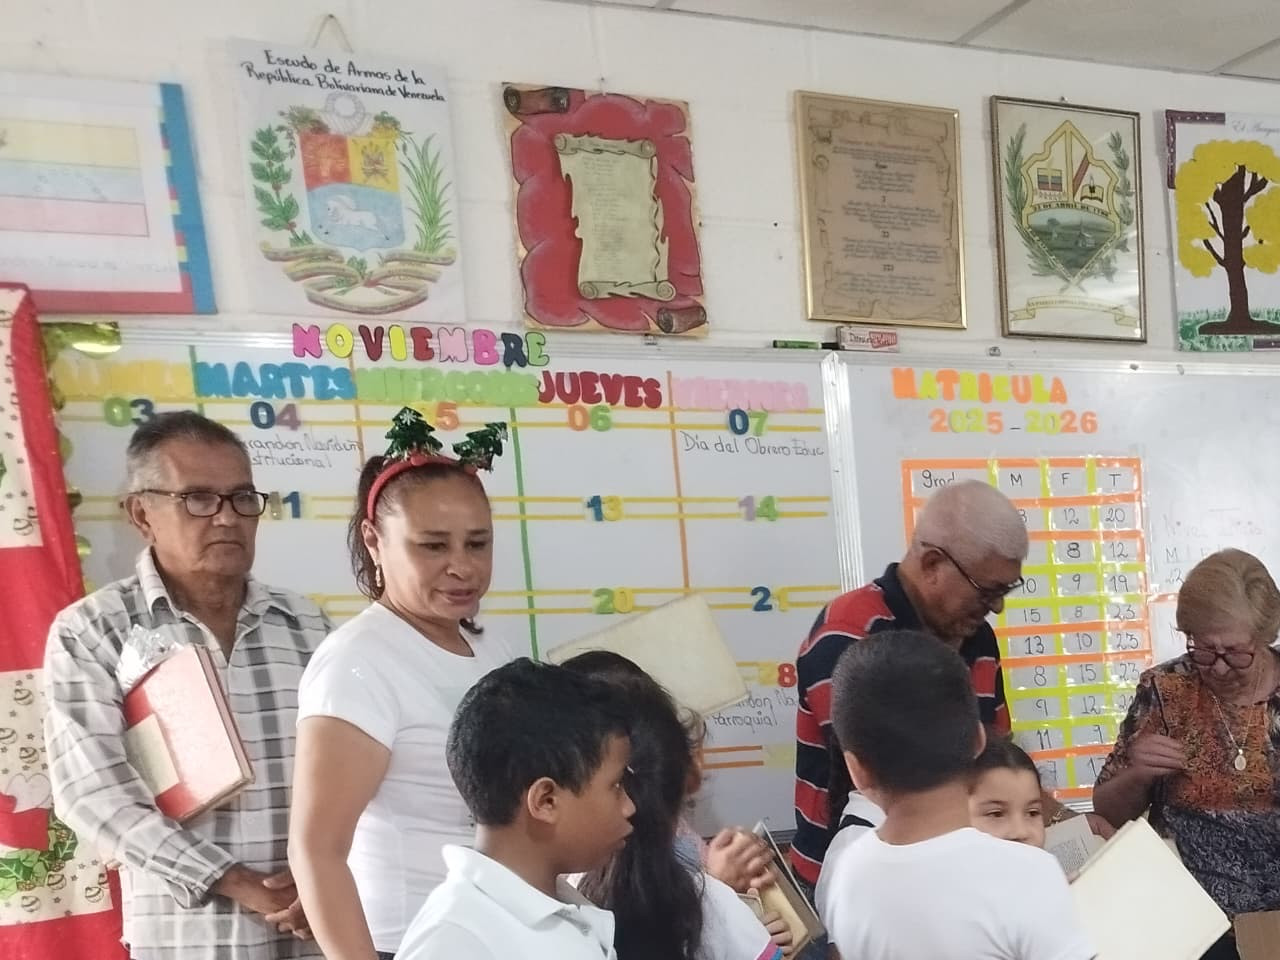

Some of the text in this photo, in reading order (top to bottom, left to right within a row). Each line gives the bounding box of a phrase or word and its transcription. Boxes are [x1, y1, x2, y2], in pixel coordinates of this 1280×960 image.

[264, 50, 426, 85] Escudo de Armas de la
[385, 85, 397, 96] de
[398, 87, 446, 102] Venezuela
[292, 323, 550, 366] NOVIEMBRE
[194, 361, 358, 401] MARTES
[537, 370, 662, 410] JUEVES
[891, 368, 1067, 405] MATRICULA
[104, 397, 154, 427] 03
[250, 400, 301, 431] 04
[415, 401, 460, 431] 5
[567, 405, 613, 431] 06
[728, 408, 769, 437] 07
[714, 436, 738, 453] del
[745, 437, 790, 456] Obrero
[1010, 473, 1023, 486] M
[1062, 473, 1070, 485] F
[1109, 473, 1122, 487] T
[586, 495, 624, 521] 13
[738, 496, 779, 521] 14
[1063, 508, 1079, 524] 12
[1105, 507, 1126, 523] 20
[1067, 542, 1081, 558] 8
[1110, 542, 1128, 560] 12
[1072, 574, 1081, 590] 9
[1109, 575, 1129, 593] 19
[593, 588, 634, 615] 20
[1023, 608, 1041, 623] 15
[1074, 606, 1083, 618] 8
[1112, 604, 1136, 621] 23
[1025, 635, 1045, 655] 13
[1077, 632, 1093, 650] 10
[1034, 665, 1047, 687] 8
[1079, 663, 1097, 683] 15
[1119, 662, 1140, 681] 23
[1036, 698, 1049, 717] 9
[1082, 695, 1100, 715] 12
[1036, 728, 1052, 750] 11
